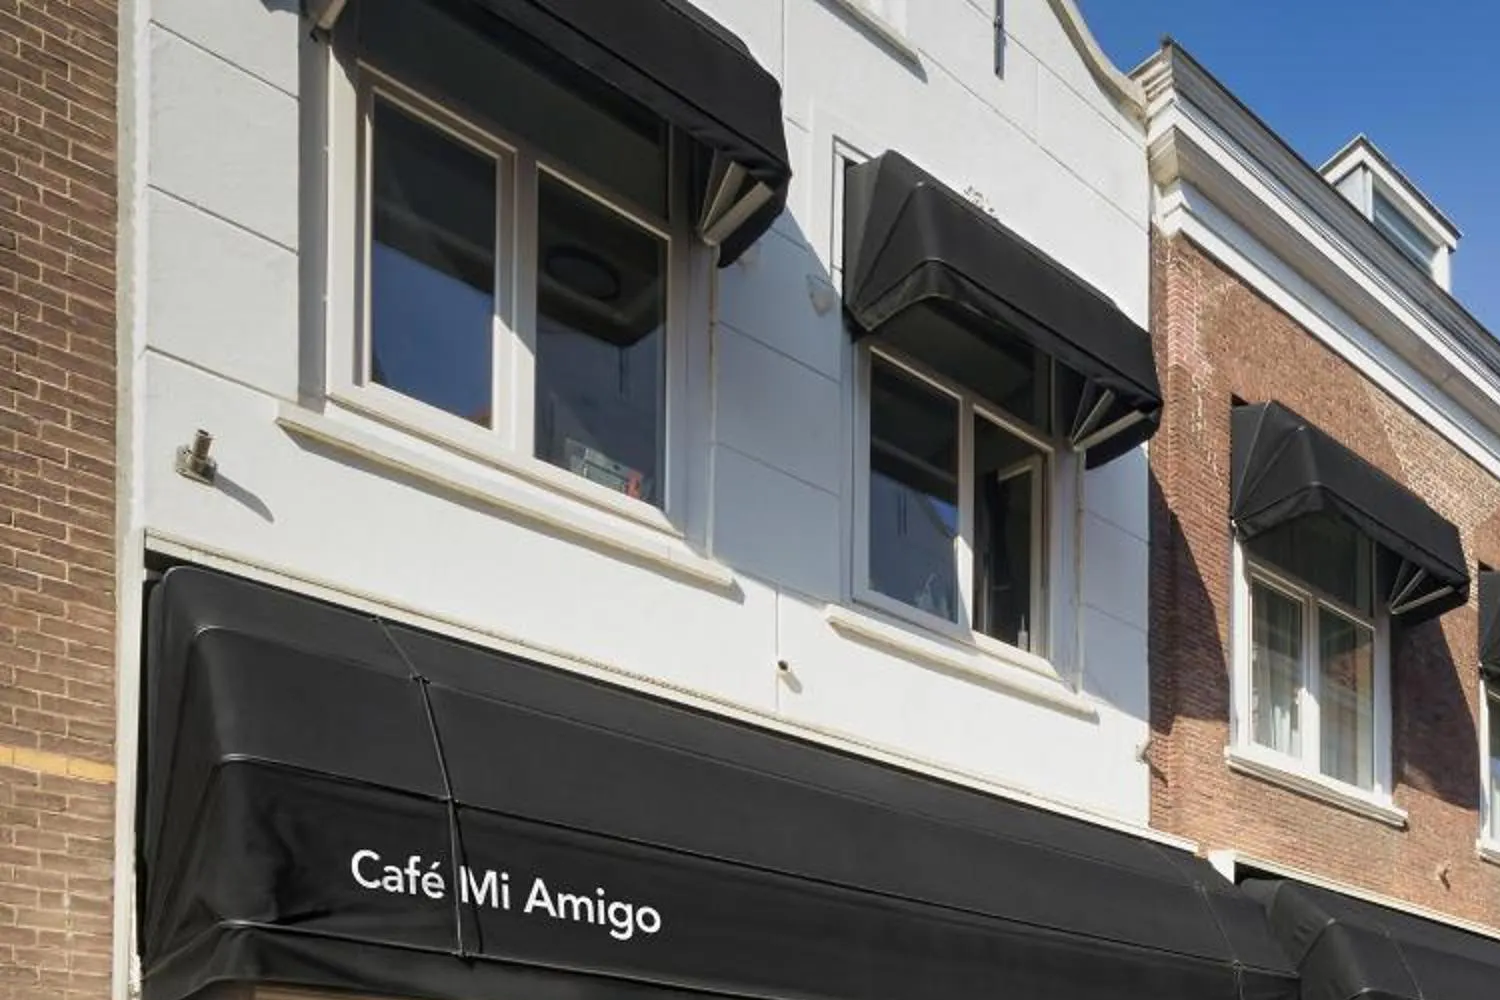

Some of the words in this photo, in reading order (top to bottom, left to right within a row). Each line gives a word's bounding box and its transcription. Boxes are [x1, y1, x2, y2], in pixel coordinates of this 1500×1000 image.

[351, 848, 445, 900] Café
[459, 865, 511, 911] Mi
[523, 877, 662, 942] Amigo
